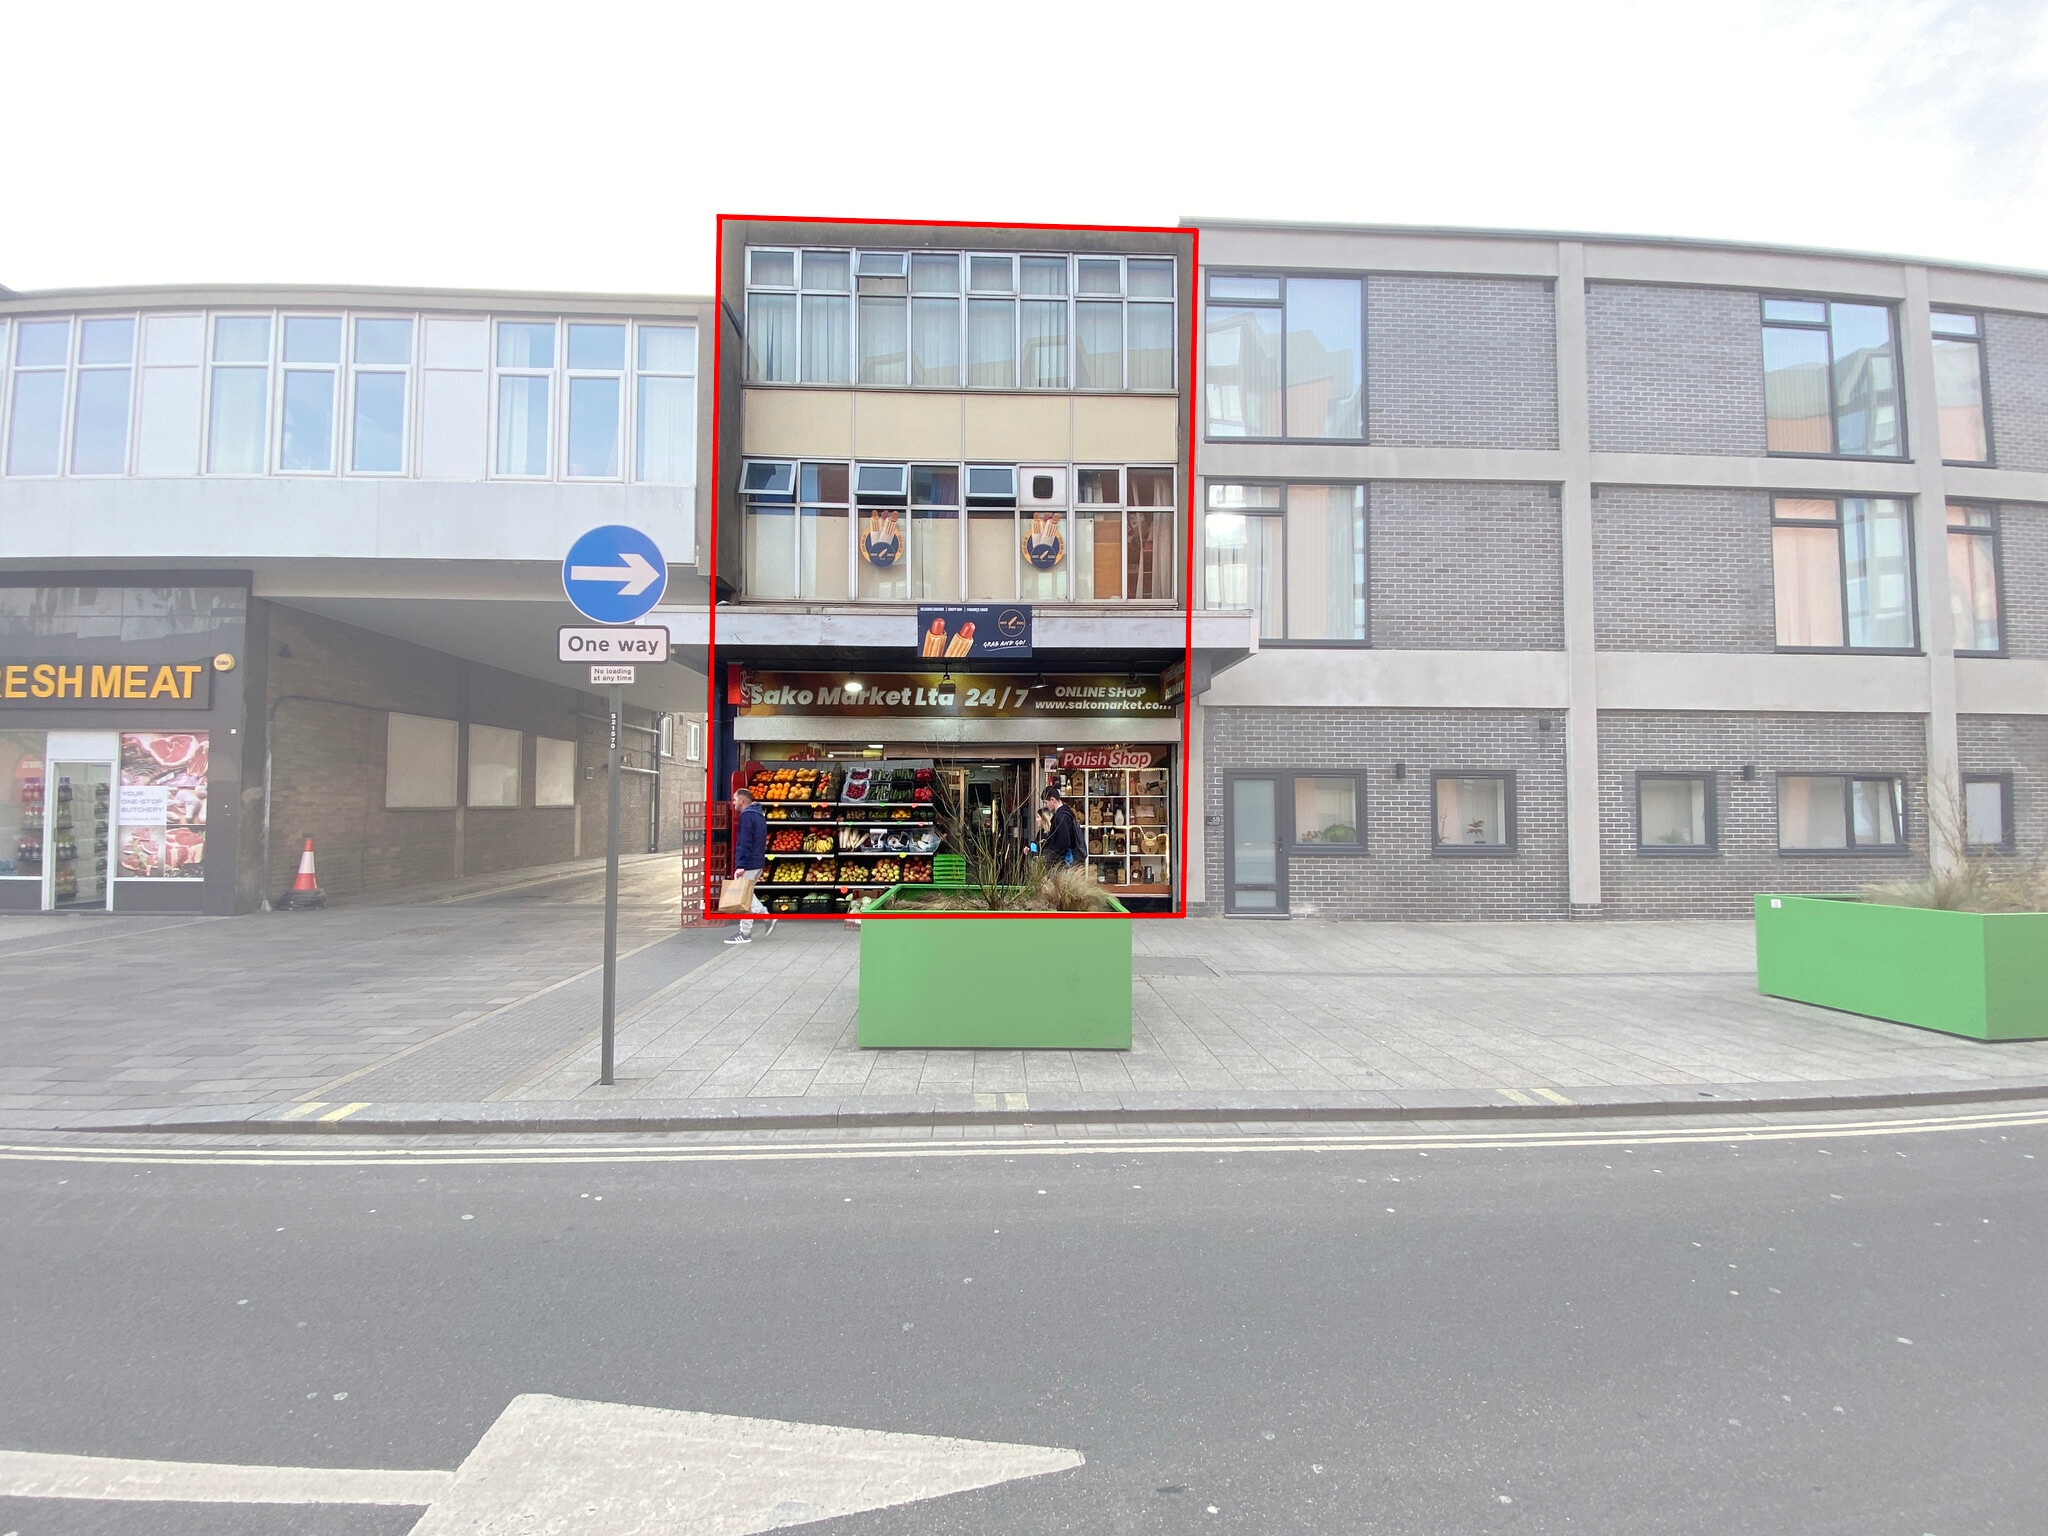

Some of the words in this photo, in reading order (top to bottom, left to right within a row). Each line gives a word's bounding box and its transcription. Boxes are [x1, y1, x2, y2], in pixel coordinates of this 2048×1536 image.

[568, 635, 610, 652] One
[618, 640, 659, 655] way
[0, 663, 84, 699] ESH
[91, 664, 202, 699] MEAT
[606, 668, 632, 676] loading
[750, 684, 813, 705] Sako
[817, 685, 911, 706] Market
[1055, 686, 1107, 698] ONLINE
[1107, 686, 1147, 698] SHOP
[1063, 751, 1107, 767] Polish
[1111, 750, 1149, 768] Shop
